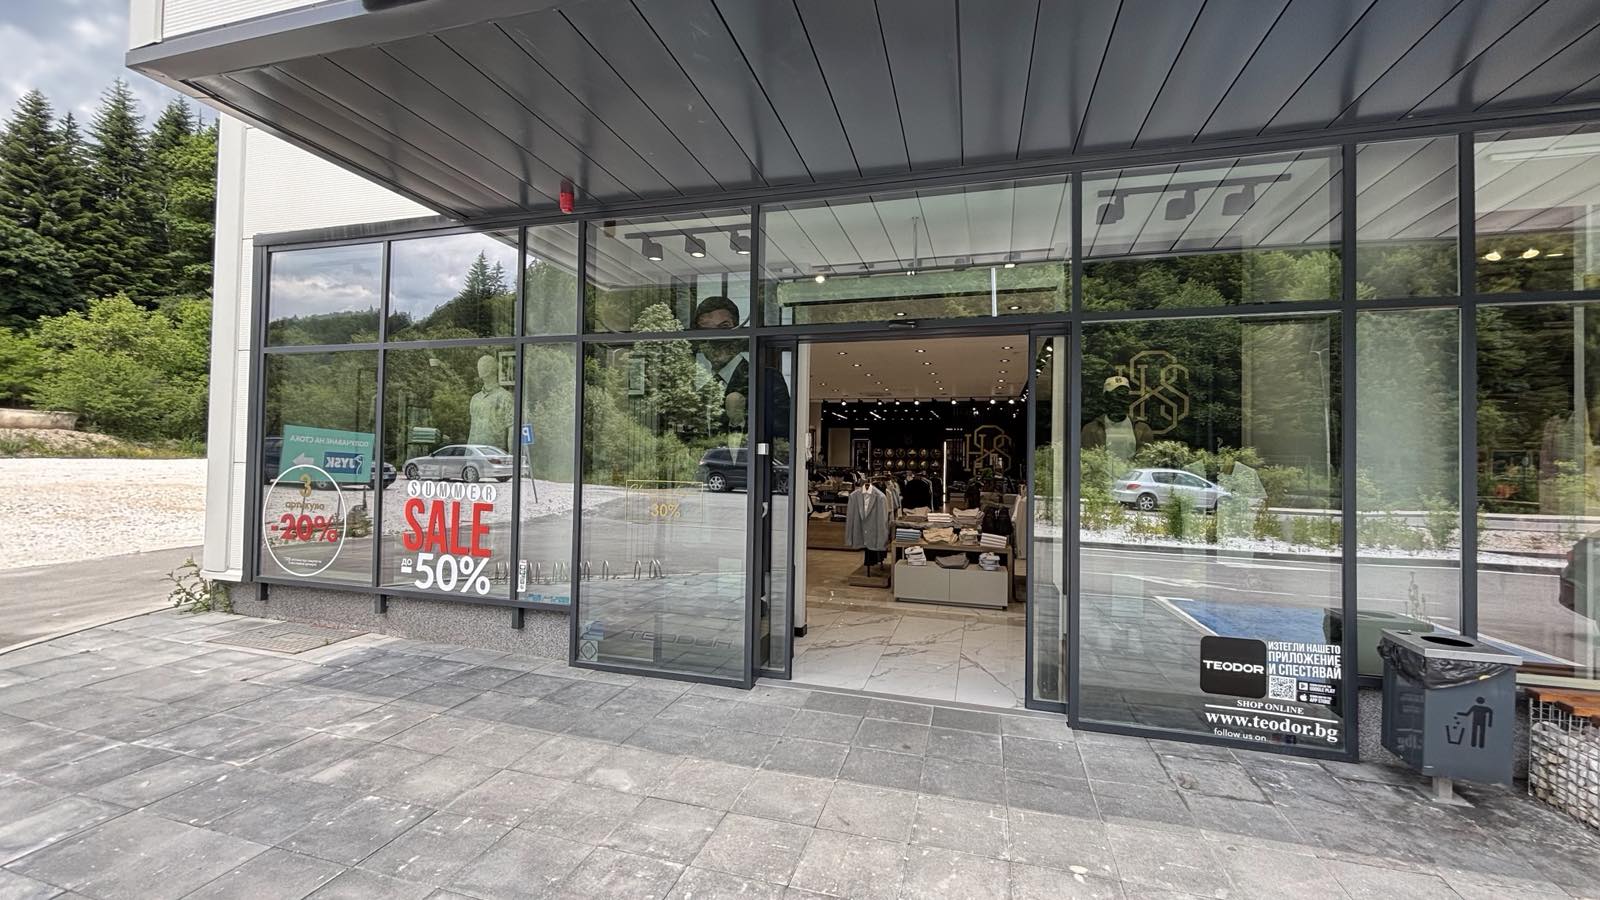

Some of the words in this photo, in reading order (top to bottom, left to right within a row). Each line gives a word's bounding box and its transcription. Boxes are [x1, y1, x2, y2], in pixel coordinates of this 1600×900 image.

[408, 480, 495, 501] SUMMER
[271, 513, 339, 543] -20%
[402, 498, 494, 557] SALE
[1268, 641, 1305, 651] ИЗТЕГЛИ
[1306, 643, 1341, 654] НАШЕТО
[1268, 651, 1341, 666] ПРИЛОЖЕНИЕ
[1203, 660, 1264, 674] TEODOR
[1269, 663, 1276, 675] И
[1279, 664, 1342, 680] СПЕСТЯВАЙ
[1236, 700, 1264, 710] SHOP
[1265, 703, 1304, 715] ONLINE
[1205, 712, 1339, 743] www.teodor.bg
[1214, 728, 1240, 738] follow
